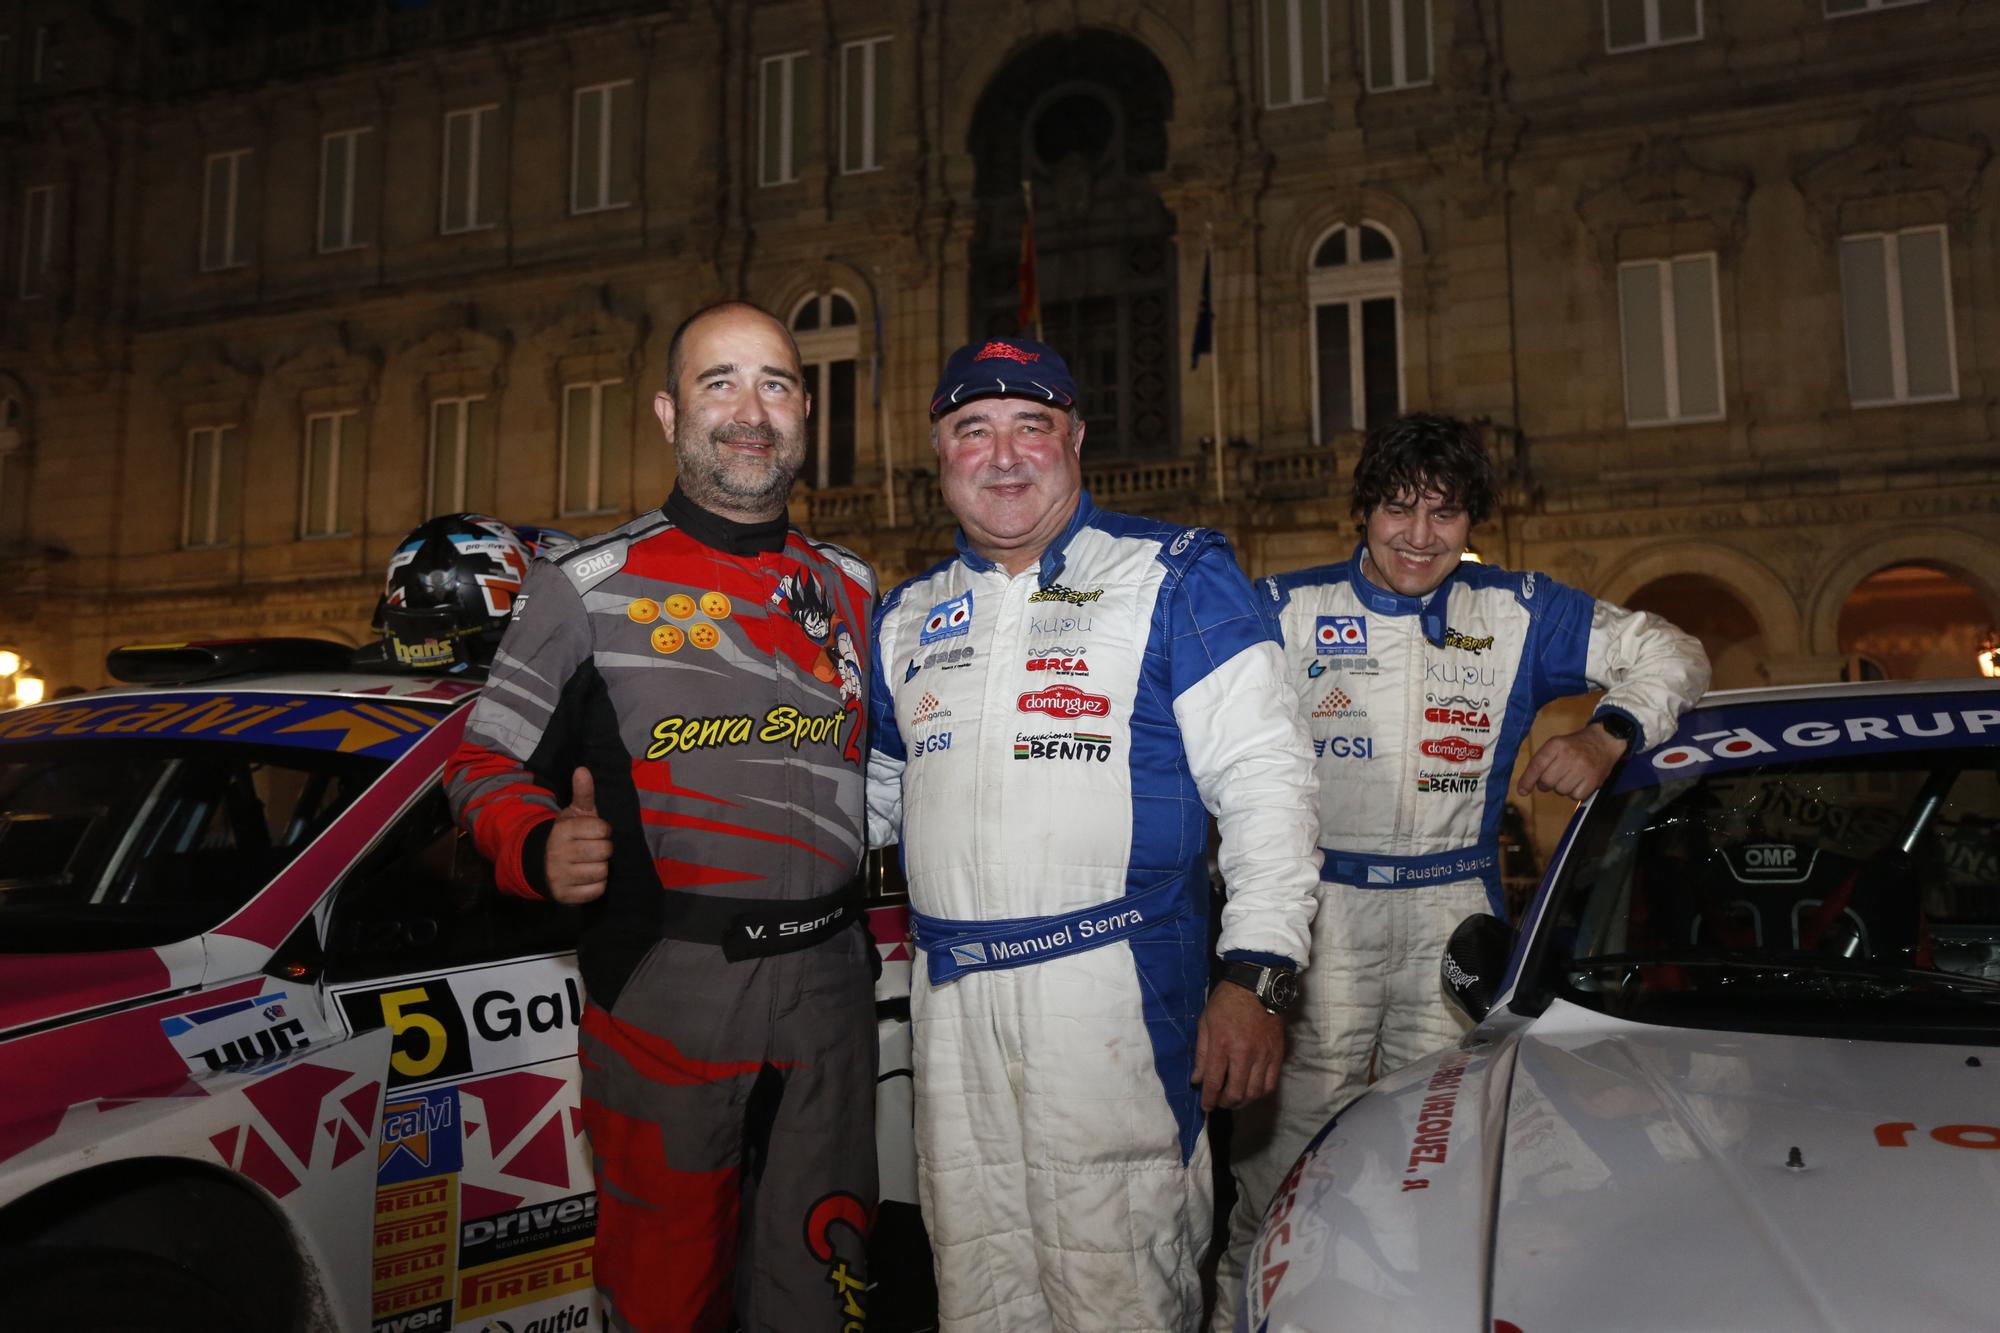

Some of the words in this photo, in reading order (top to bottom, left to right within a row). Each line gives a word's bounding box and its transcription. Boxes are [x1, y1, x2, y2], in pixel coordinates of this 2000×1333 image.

[576, 552, 615, 579] OMP
[1026, 658, 1089, 672] GERCA
[1425, 656, 1496, 691] kupu
[1026, 694, 1104, 715] dominguez
[1425, 708, 1490, 728] GERCA
[647, 716, 752, 760] Senra
[760, 705, 845, 748] Sport
[926, 732, 952, 753] GSI
[1782, 709, 2000, 748] GRUP
[1030, 741, 1111, 762] BENITO
[1331, 736, 1373, 760] GSI
[1430, 778, 1478, 793] BENITO
[1745, 848, 1797, 867] OMP
[745, 925, 768, 940] V.
[779, 906, 844, 938] Senra
[990, 925, 1073, 961] Manuel
[1079, 908, 1143, 938] Senra
[379, 987, 449, 1077] 5
[381, 1097, 452, 1144] calvi
[376, 1179, 448, 1214] RELLI
[374, 1211, 448, 1247] RELLI
[373, 1244, 447, 1281] RELLI
[461, 1247, 593, 1309] PIRELL
[372, 1276, 445, 1315] RELLI
